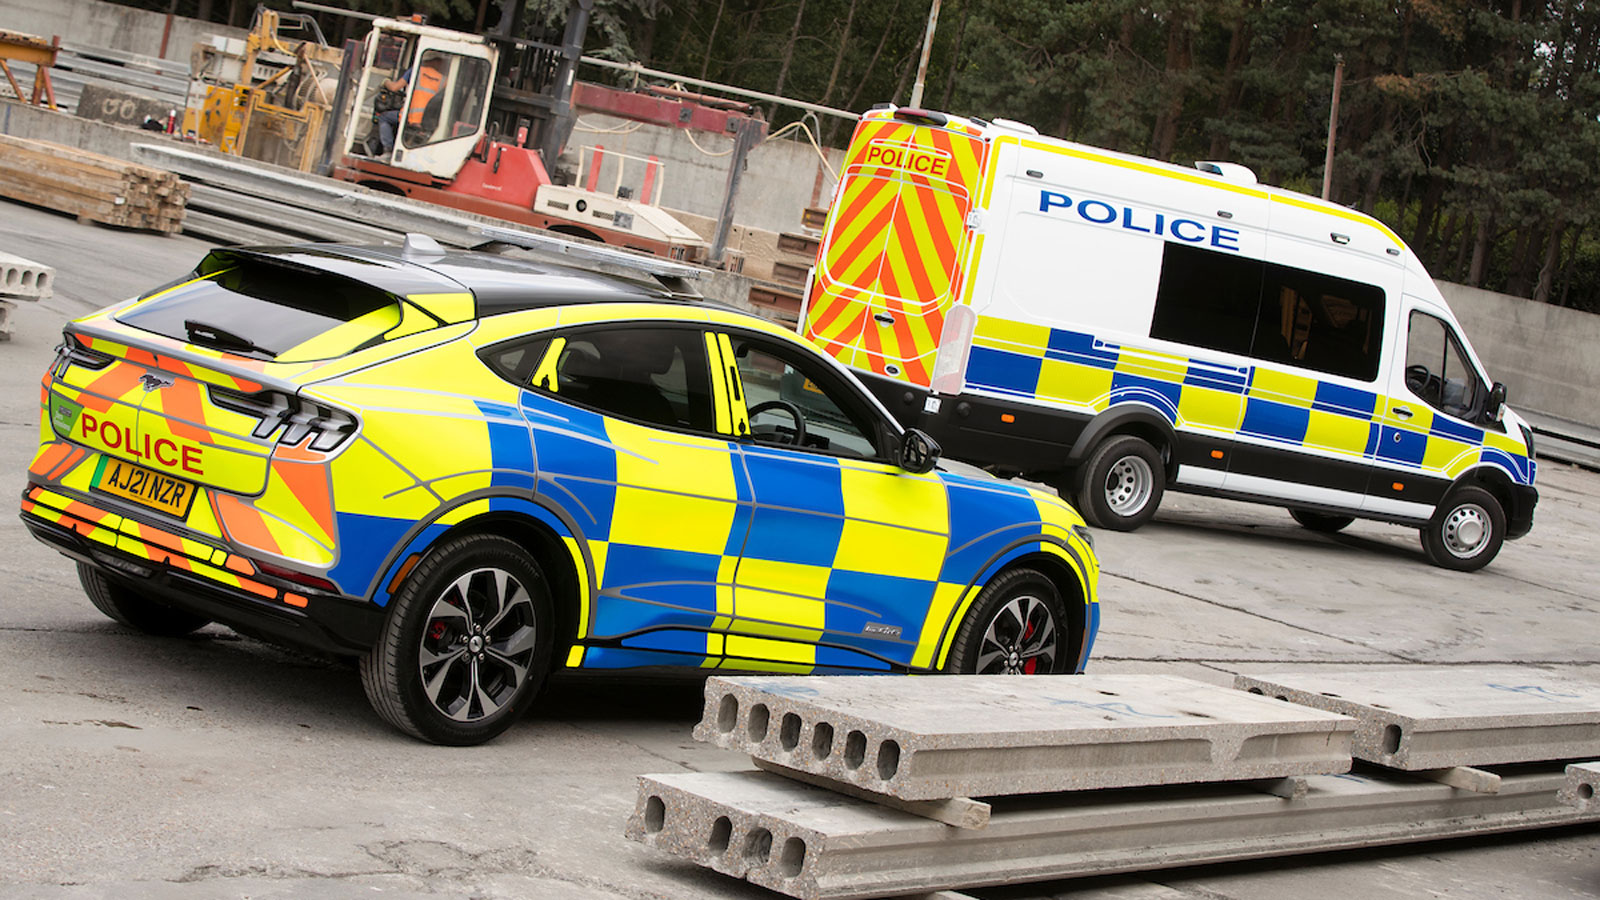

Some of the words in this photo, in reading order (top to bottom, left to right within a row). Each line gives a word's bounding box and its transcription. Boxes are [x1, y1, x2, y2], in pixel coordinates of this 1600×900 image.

[867, 146, 946, 176] POLICE
[1039, 189, 1240, 252] POLICE
[81, 412, 204, 476] POLICE
[107, 463, 151, 496] AJ21
[147, 475, 186, 509] NZR
